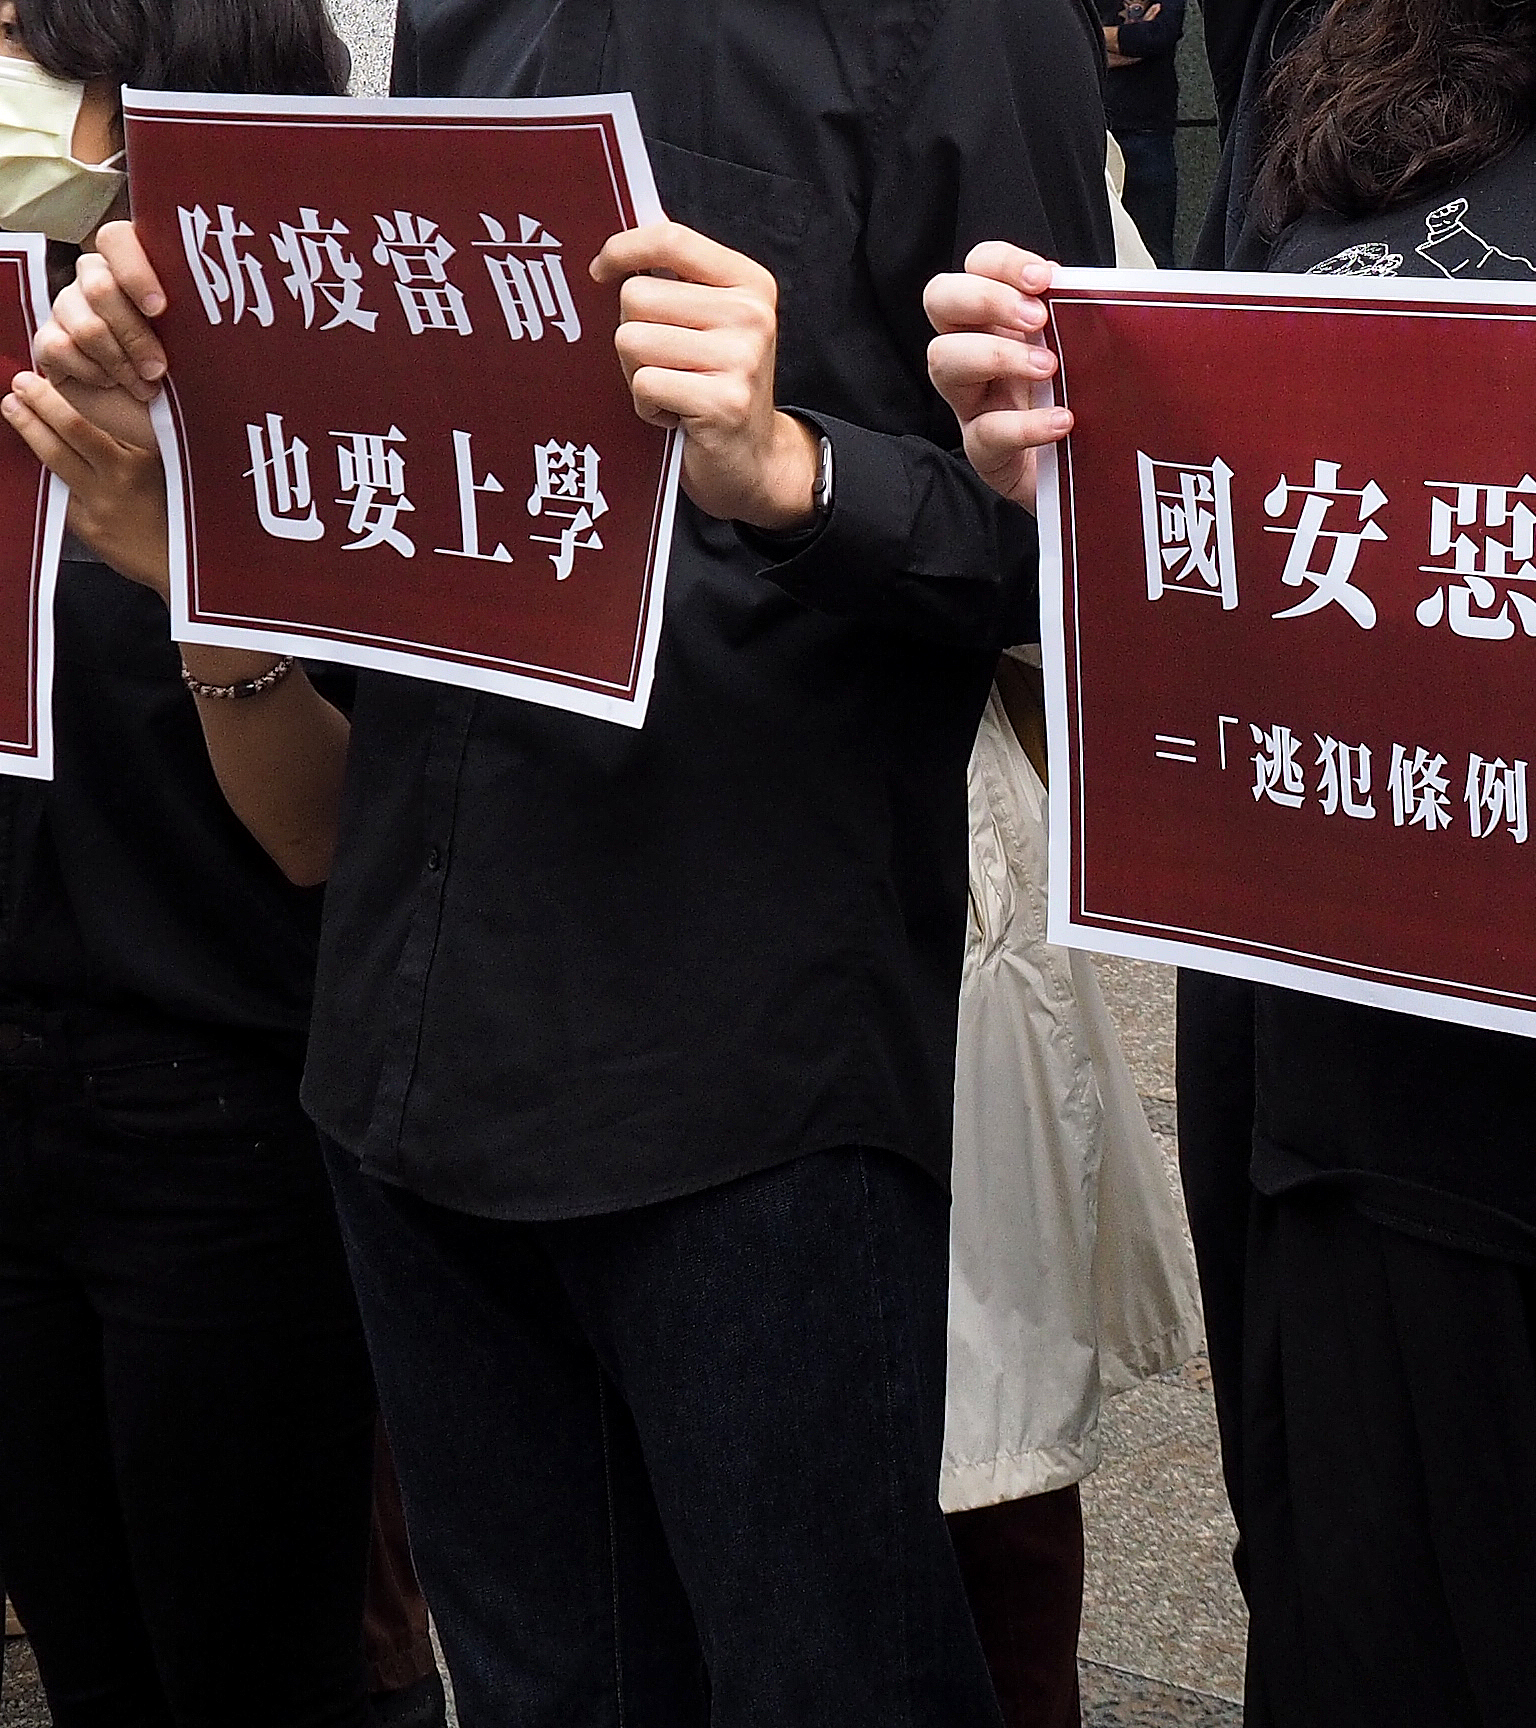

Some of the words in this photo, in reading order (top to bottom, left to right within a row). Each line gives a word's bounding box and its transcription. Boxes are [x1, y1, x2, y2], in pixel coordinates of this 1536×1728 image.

[177, 203, 583, 343] 防疫當前
[242, 412, 609, 581] 也要上學
